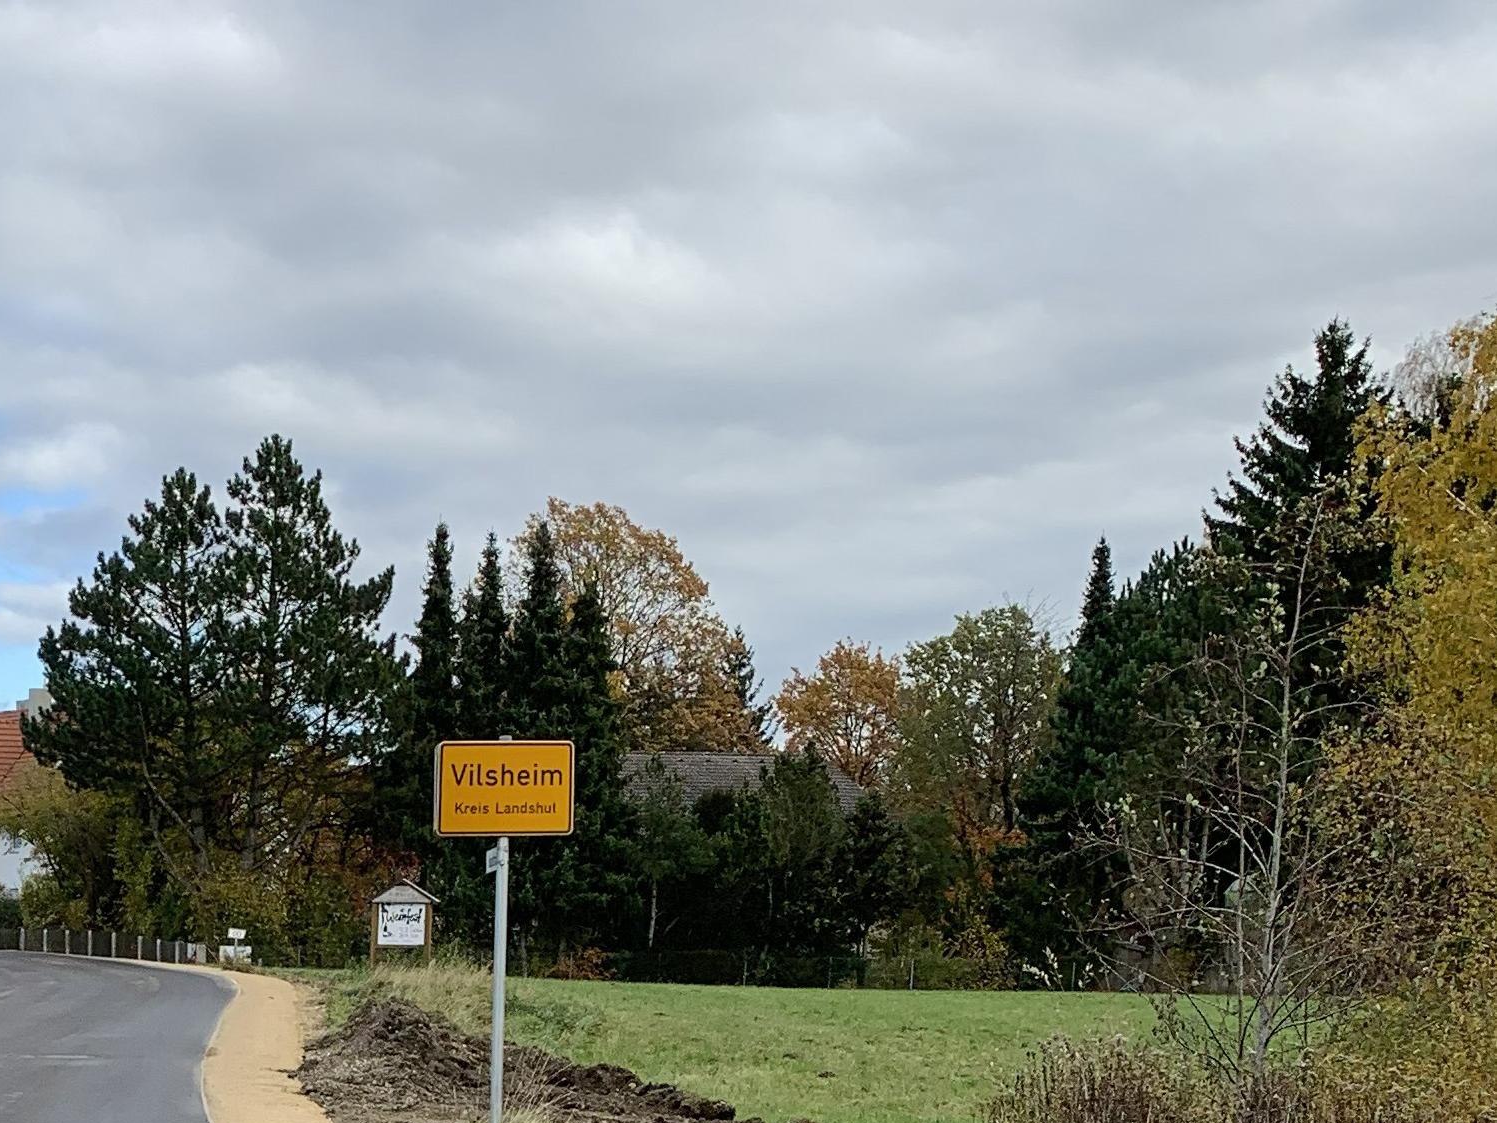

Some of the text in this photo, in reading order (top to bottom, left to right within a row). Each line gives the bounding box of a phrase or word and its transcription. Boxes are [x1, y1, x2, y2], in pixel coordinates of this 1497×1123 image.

[451, 763, 563, 787] Vilsheim
[454, 802, 557, 815] Kreis Landshut
